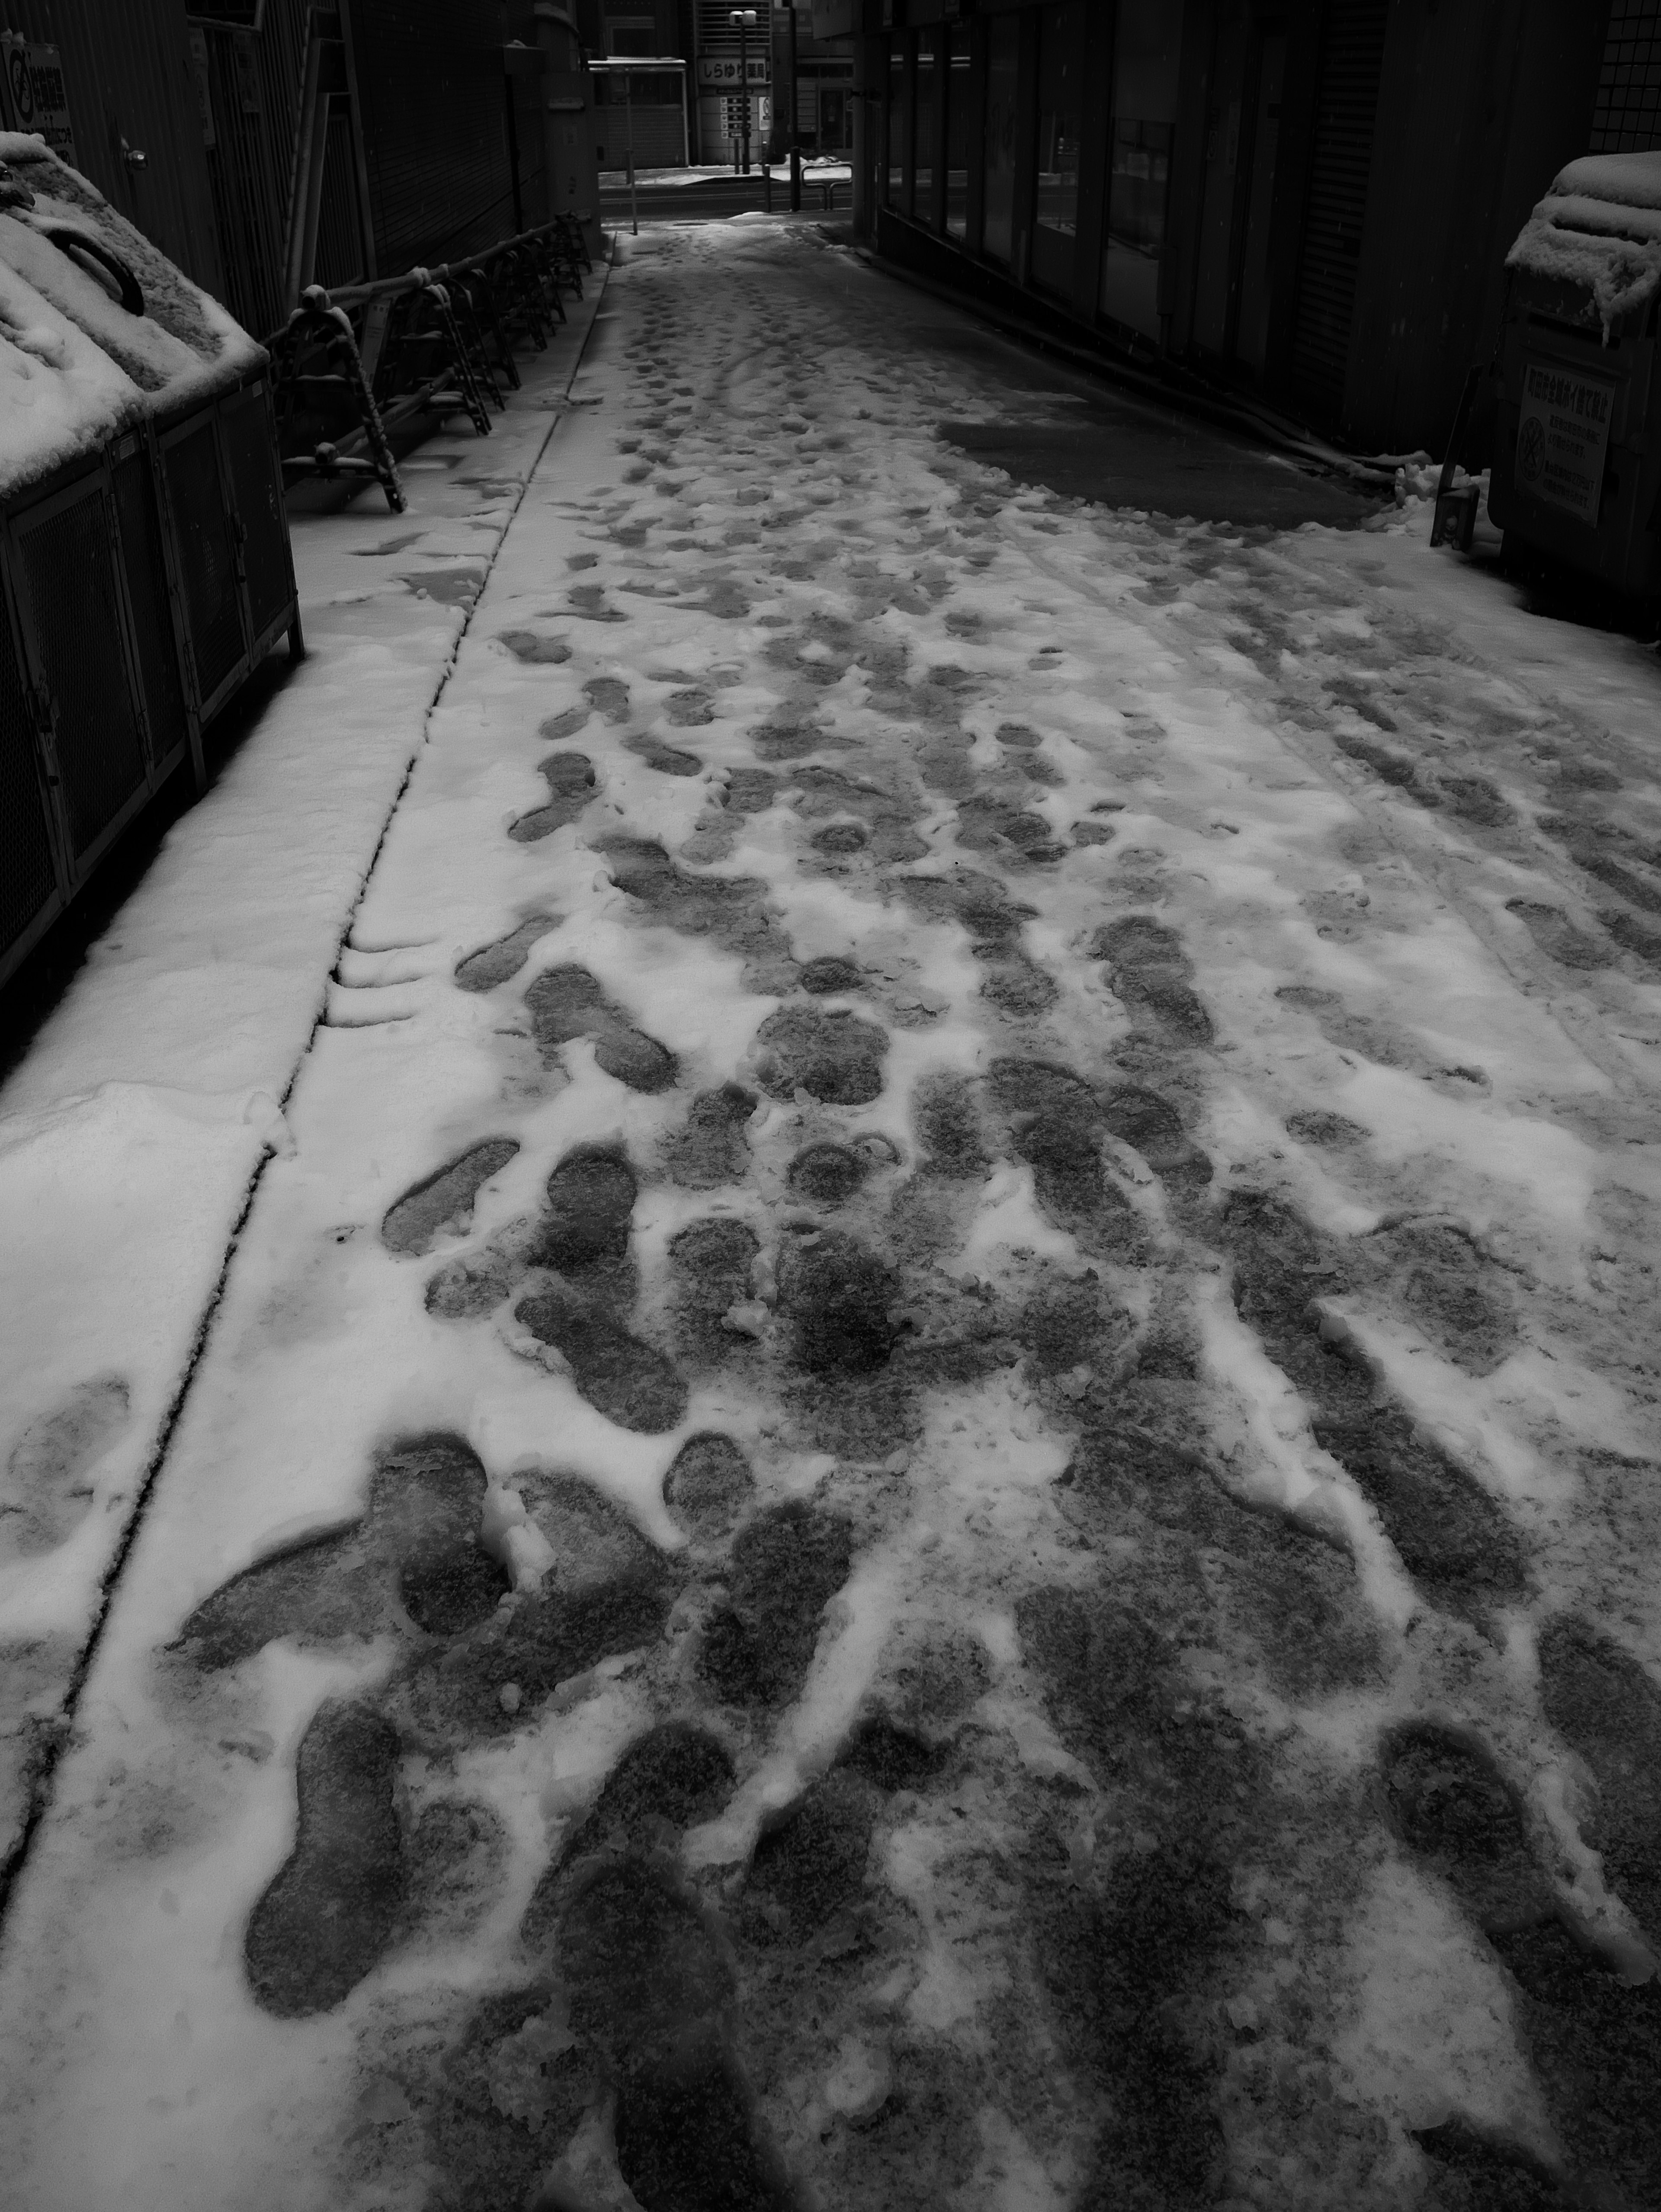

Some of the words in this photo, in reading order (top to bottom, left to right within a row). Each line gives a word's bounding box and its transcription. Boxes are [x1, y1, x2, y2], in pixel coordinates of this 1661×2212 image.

[1527, 367, 1608, 424] 町田市全域ポイ捨て禁止
